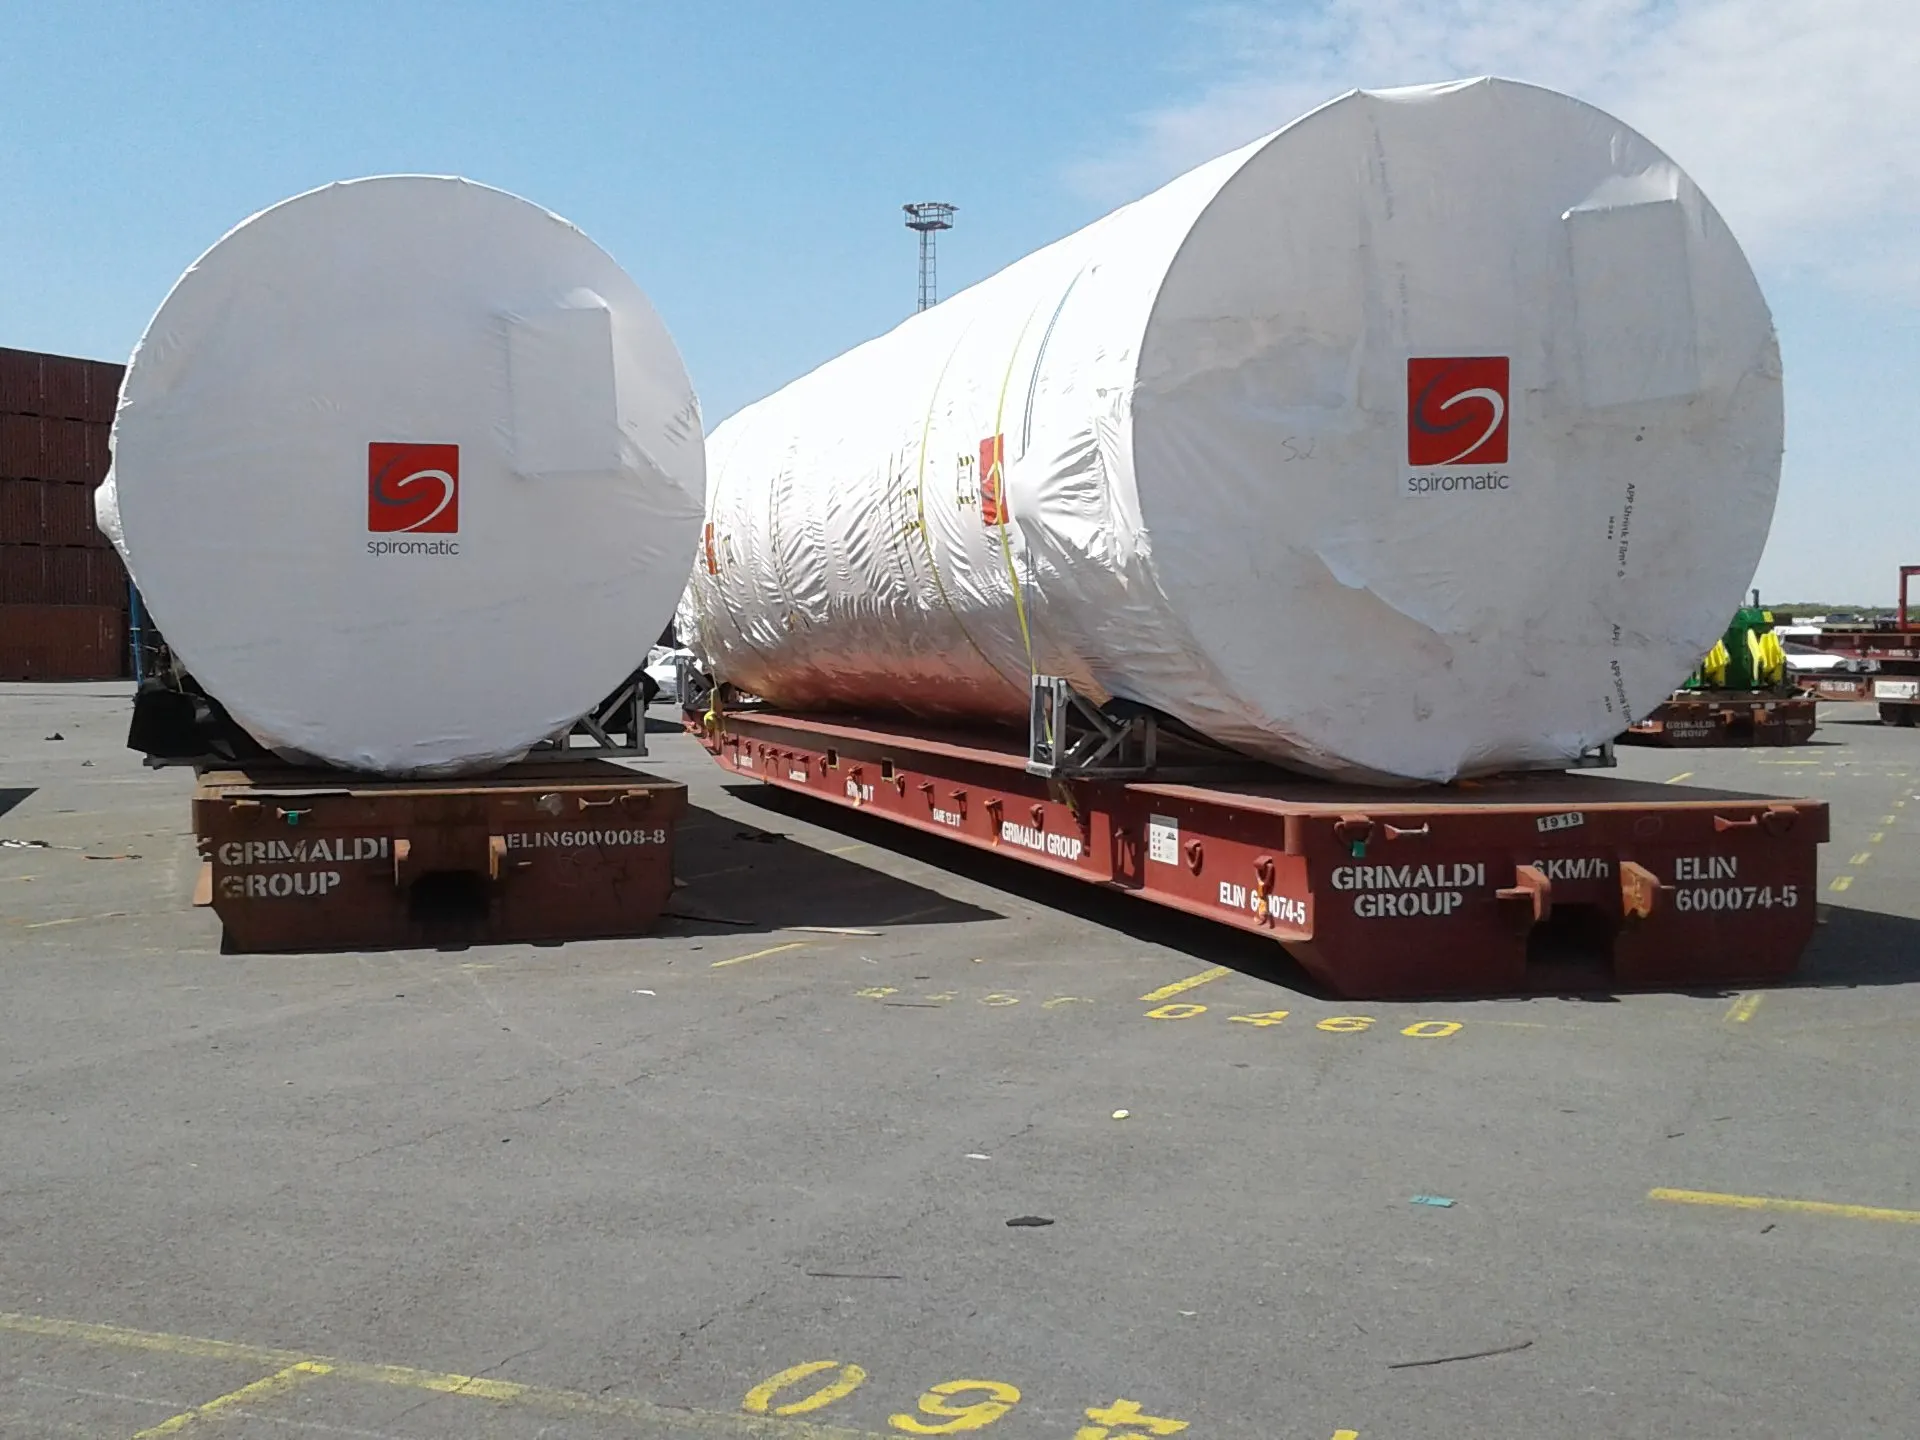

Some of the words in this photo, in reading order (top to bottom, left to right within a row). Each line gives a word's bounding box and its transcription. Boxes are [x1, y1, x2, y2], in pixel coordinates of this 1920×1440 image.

[1408, 471, 1509, 494] spiromatic
[367, 538, 459, 556] spiromatic
[218, 837, 388, 866] GRIMALDI
[1002, 821, 1045, 852] GRIMALDI
[1047, 833, 1081, 860] GROUP
[1331, 863, 1485, 890] GRIMALDI
[1676, 856, 1737, 881] ELIN
[219, 871, 341, 898] GROUP
[1219, 881, 1246, 909] ELIN
[1354, 891, 1463, 917] GROUP
[1676, 886, 1799, 911] 600074-5
